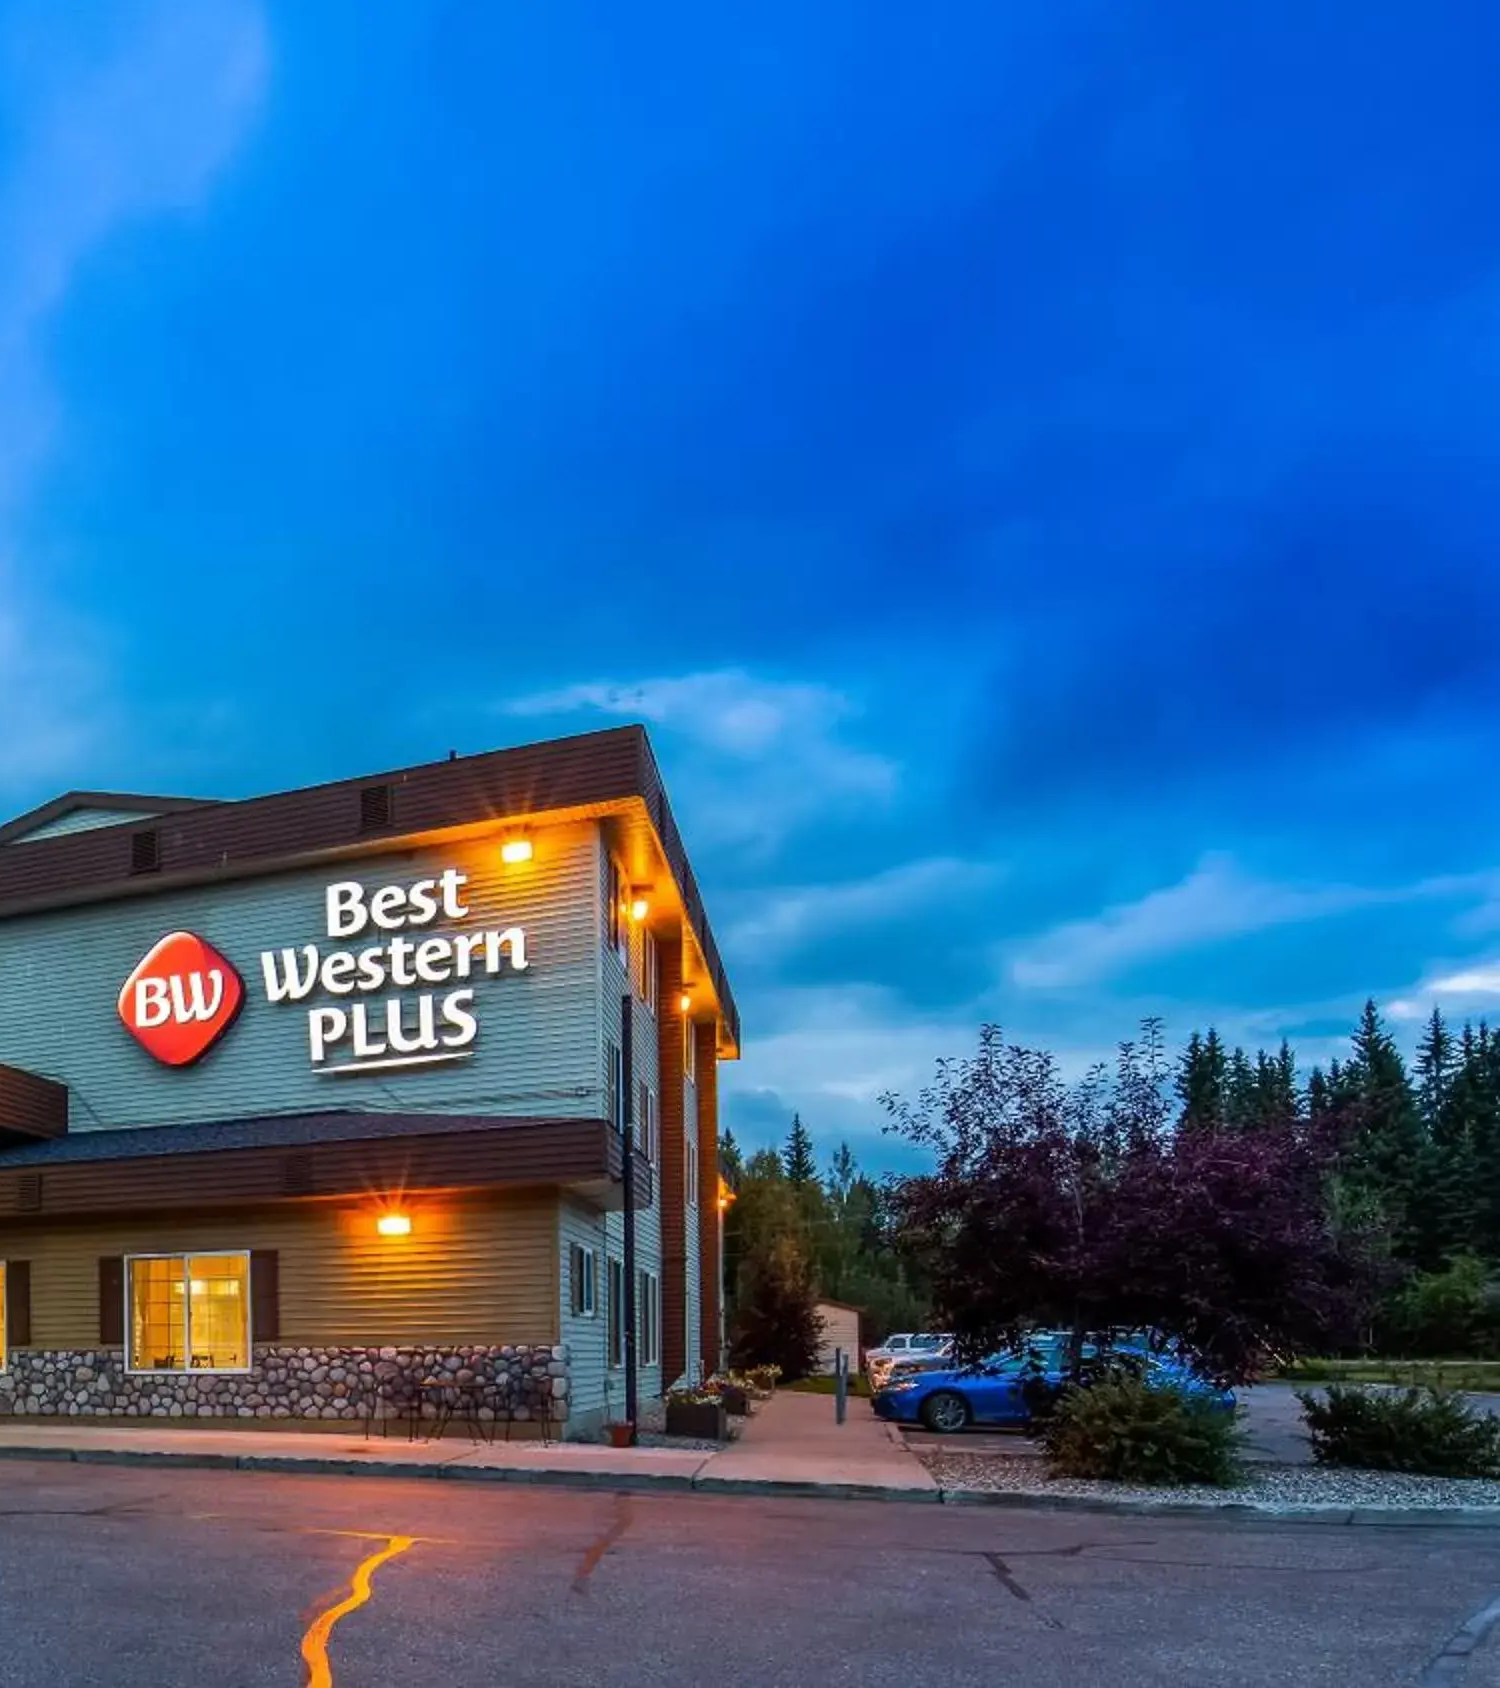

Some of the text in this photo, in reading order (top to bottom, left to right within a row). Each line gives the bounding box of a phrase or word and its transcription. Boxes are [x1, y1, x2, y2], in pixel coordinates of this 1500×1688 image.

[326, 868, 469, 937] Best
[134, 969, 223, 1028] BW
[260, 926, 530, 1002] Western
[309, 989, 479, 1061] PLUS
